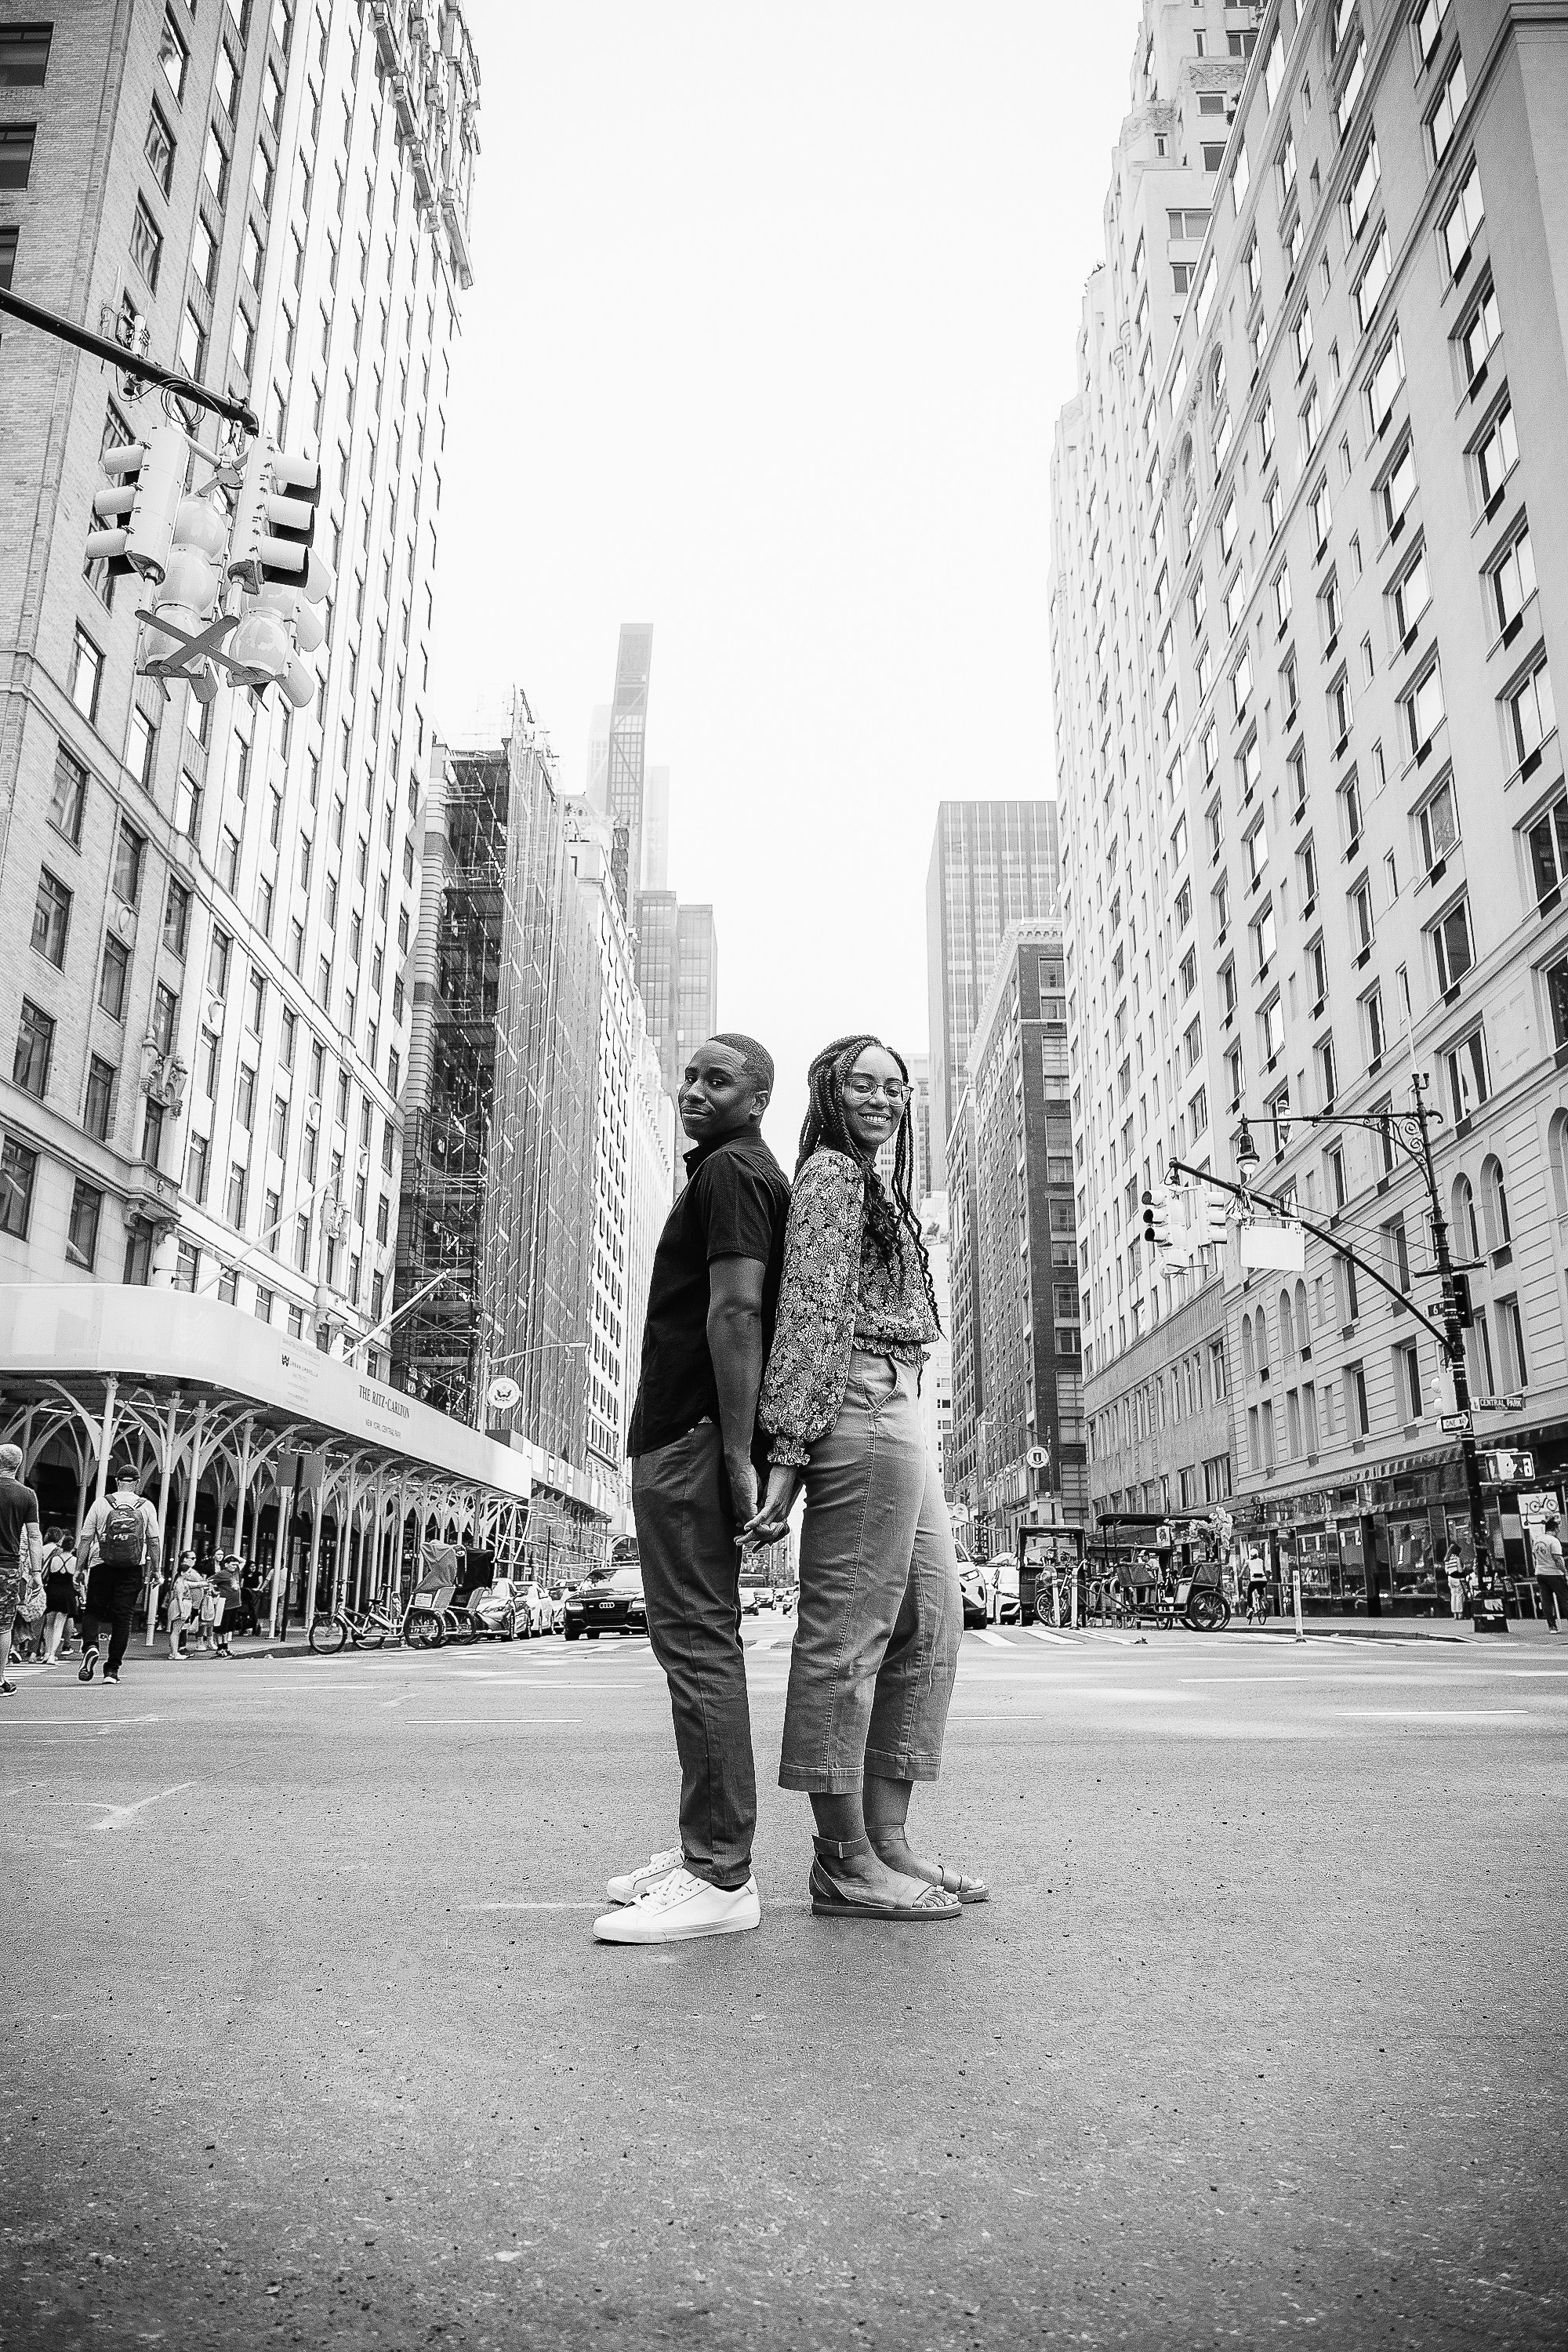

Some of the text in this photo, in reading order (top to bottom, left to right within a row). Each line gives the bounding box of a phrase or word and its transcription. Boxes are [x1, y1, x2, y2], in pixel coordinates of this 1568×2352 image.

[1433, 1305, 1439, 1315] 6
[359, 1385, 371, 1402] THE
[1506, 1398, 1522, 1407] PARK
